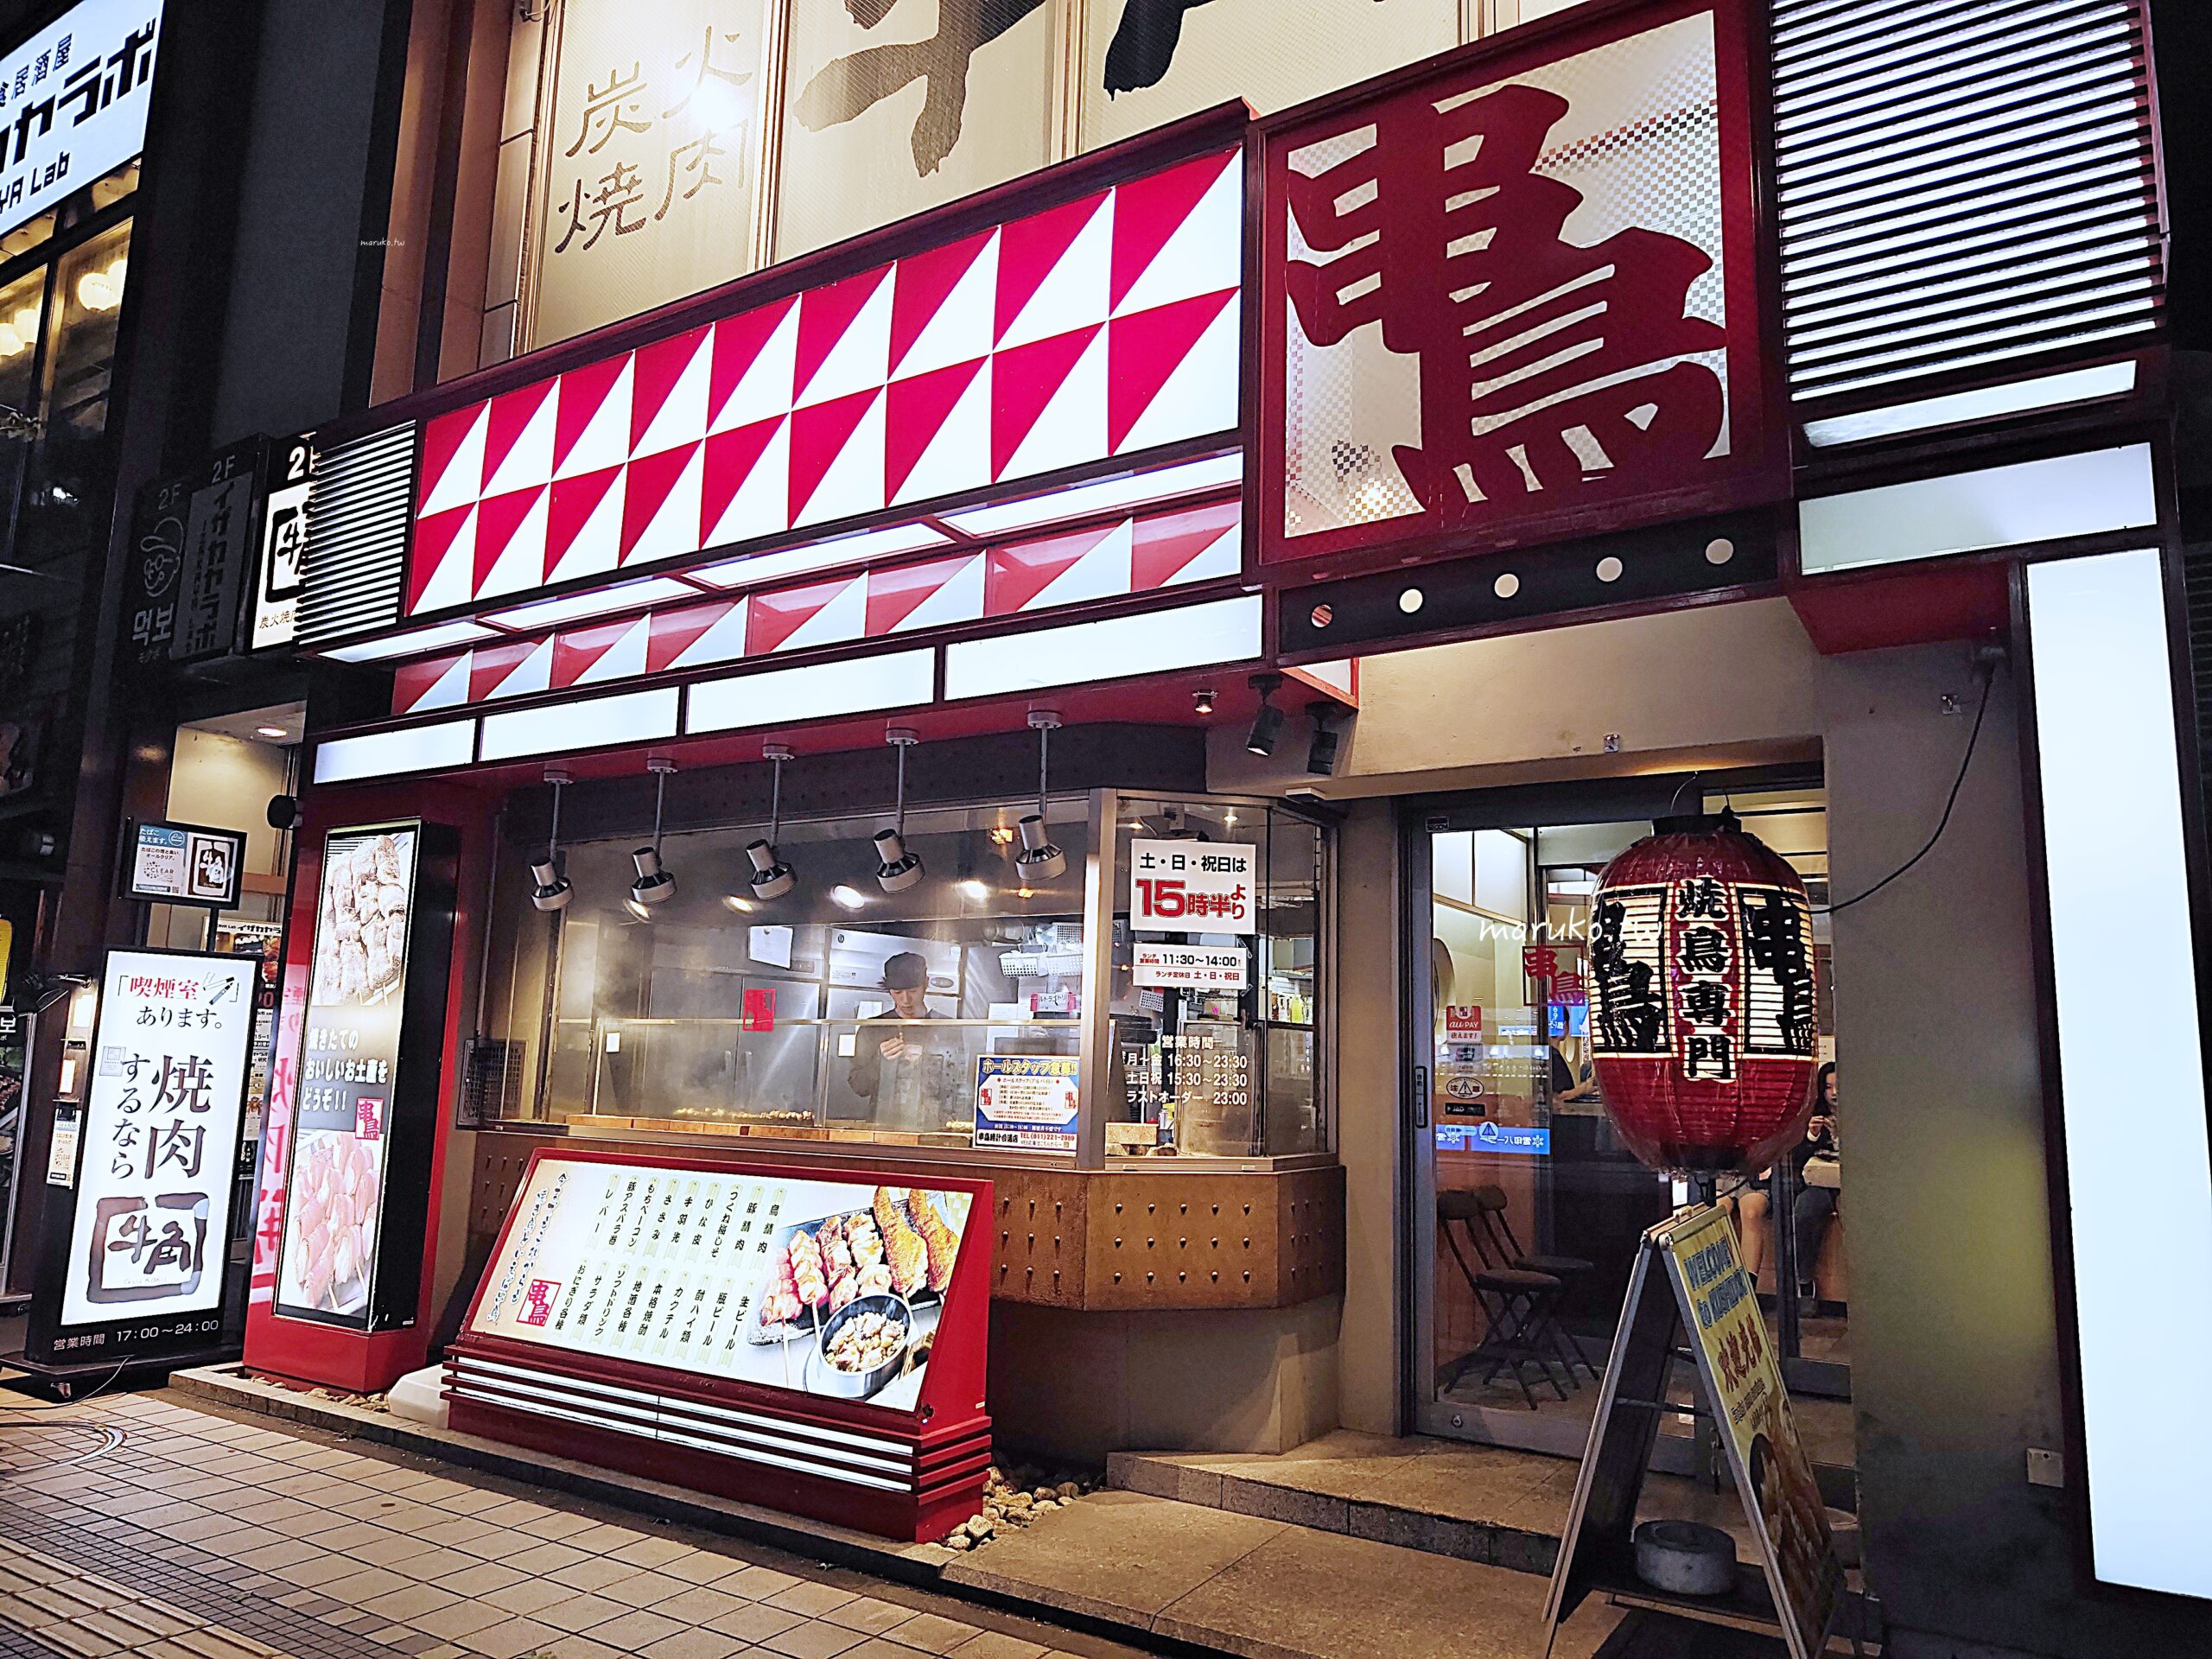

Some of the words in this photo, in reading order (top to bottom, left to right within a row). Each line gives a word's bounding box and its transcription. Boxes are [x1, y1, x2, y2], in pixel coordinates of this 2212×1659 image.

[30, 151, 70, 195] Lab
[1286, 78, 1728, 518] 串鳥
[212, 455, 235, 484] 2F
[1140, 852, 1247, 873] 土・日・祝日は
[1135, 878, 1247, 920] 15時半より
[1155, 970, 1191, 979] ランチ定休日
[1194, 971, 1241, 982] 土・日・祝日
[1523, 946, 1586, 1003] 串鳥
[137, 1006, 222, 1029] あります。
[308, 1027, 359, 1052] 焼きたての
[1161, 1034, 1214, 1050] 営業時間
[304, 1058, 388, 1084] おいしいお土産を
[1126, 1071, 1162, 1085] 土日祝
[111, 1053, 150, 1179] するなら
[144, 1054, 213, 1179] 焼肉
[358, 1100, 380, 1140] 串鳥
[1126, 1090, 1204, 1105] ラストオーダー
[1213, 1091, 1248, 1106] 23:00
[594, 1188, 613, 1233] レバー
[608, 1181, 637, 1246] 豚アスパラ巻
[628, 1183, 654, 1248] もちベーコン
[651, 1194, 672, 1241] ささみ
[671, 1196, 693, 1243] 手羽先
[691, 1198, 714, 1246] ひな皮
[107, 1215, 191, 1274] 牛角
[527, 1281, 550, 1327] 串鳥
[554, 1263, 586, 1331] おにぎり各種
[577, 1274, 603, 1325] サラダ類
[594, 1269, 626, 1337] ソフトドリンク
[618, 1280, 643, 1333] 地酒各種
[638, 1283, 663, 1336] 本格焼酎
[658, 1287, 683, 1339] カクテル
[679, 1288, 706, 1344] 酎ハイ類
[702, 1292, 728, 1346] 瓶ビール
[54, 1333, 105, 1351] 営業時間
[725, 1295, 750, 1351] 生ビール
